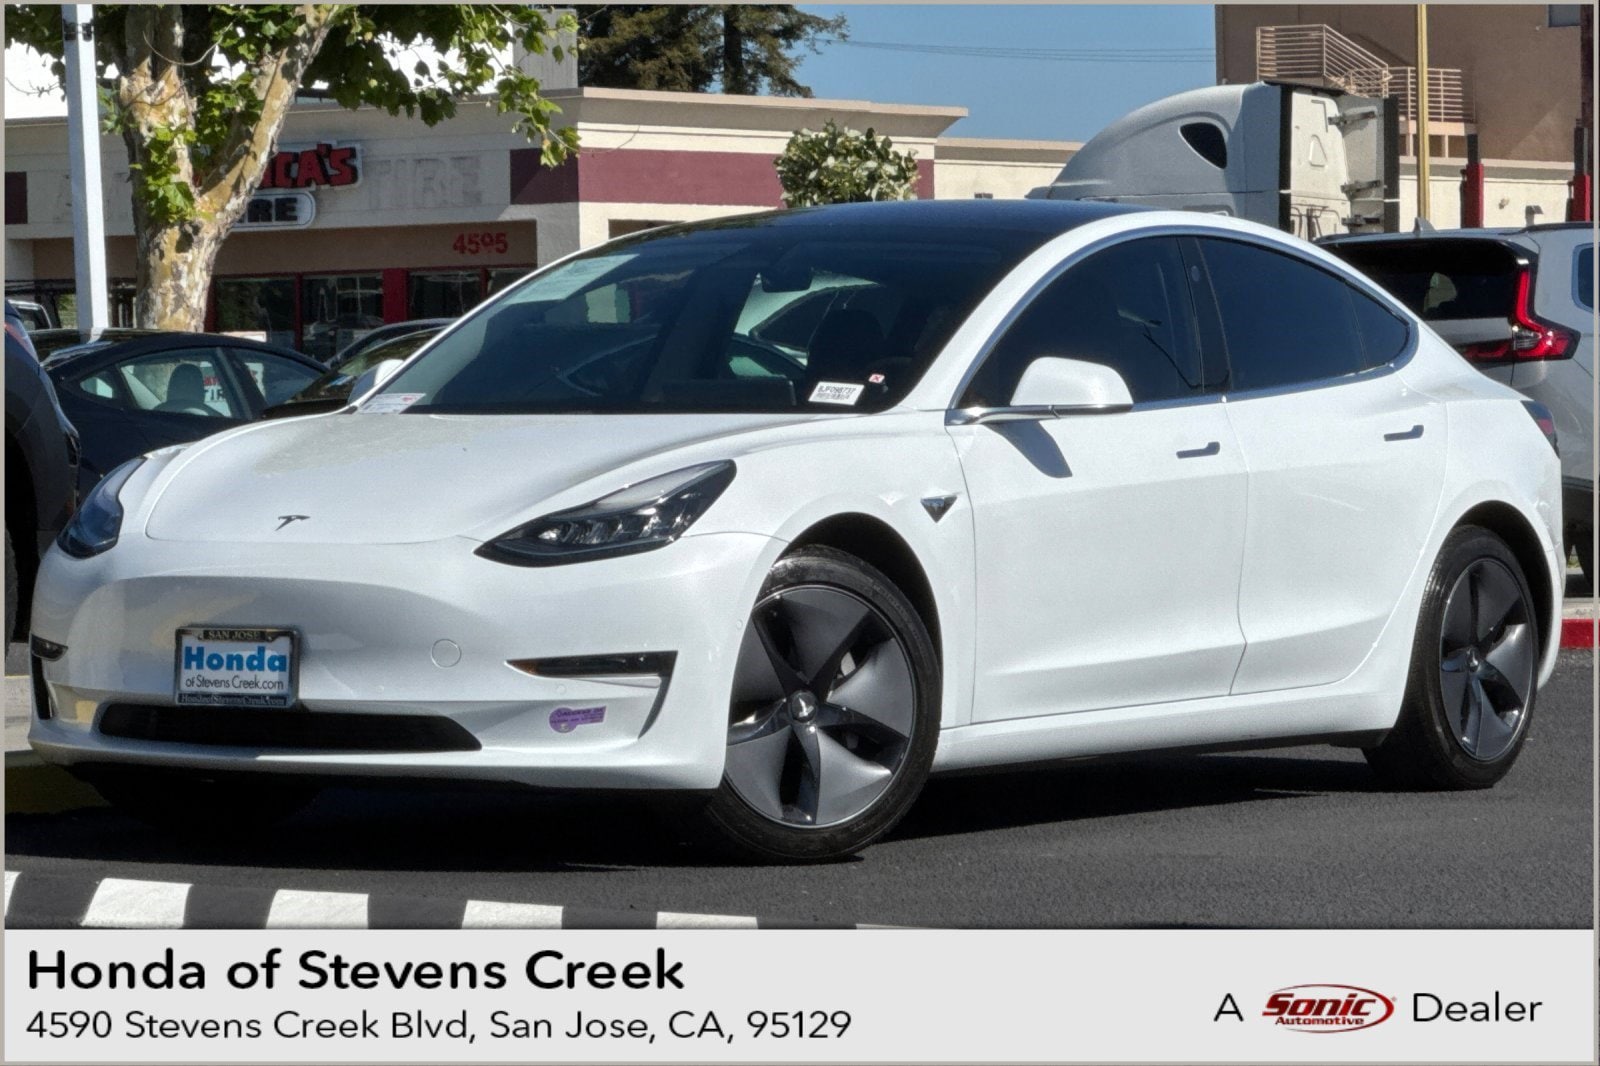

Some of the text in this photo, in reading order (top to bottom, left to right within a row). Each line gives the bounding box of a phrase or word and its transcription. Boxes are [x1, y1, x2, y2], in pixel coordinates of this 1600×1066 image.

[238, 197, 298, 223] RE
[453, 232, 508, 255] 4595
[207, 630, 262, 641] SAN JOSE
[184, 646, 288, 672] Honda
[185, 674, 284, 690] of Stevens Creek.com
